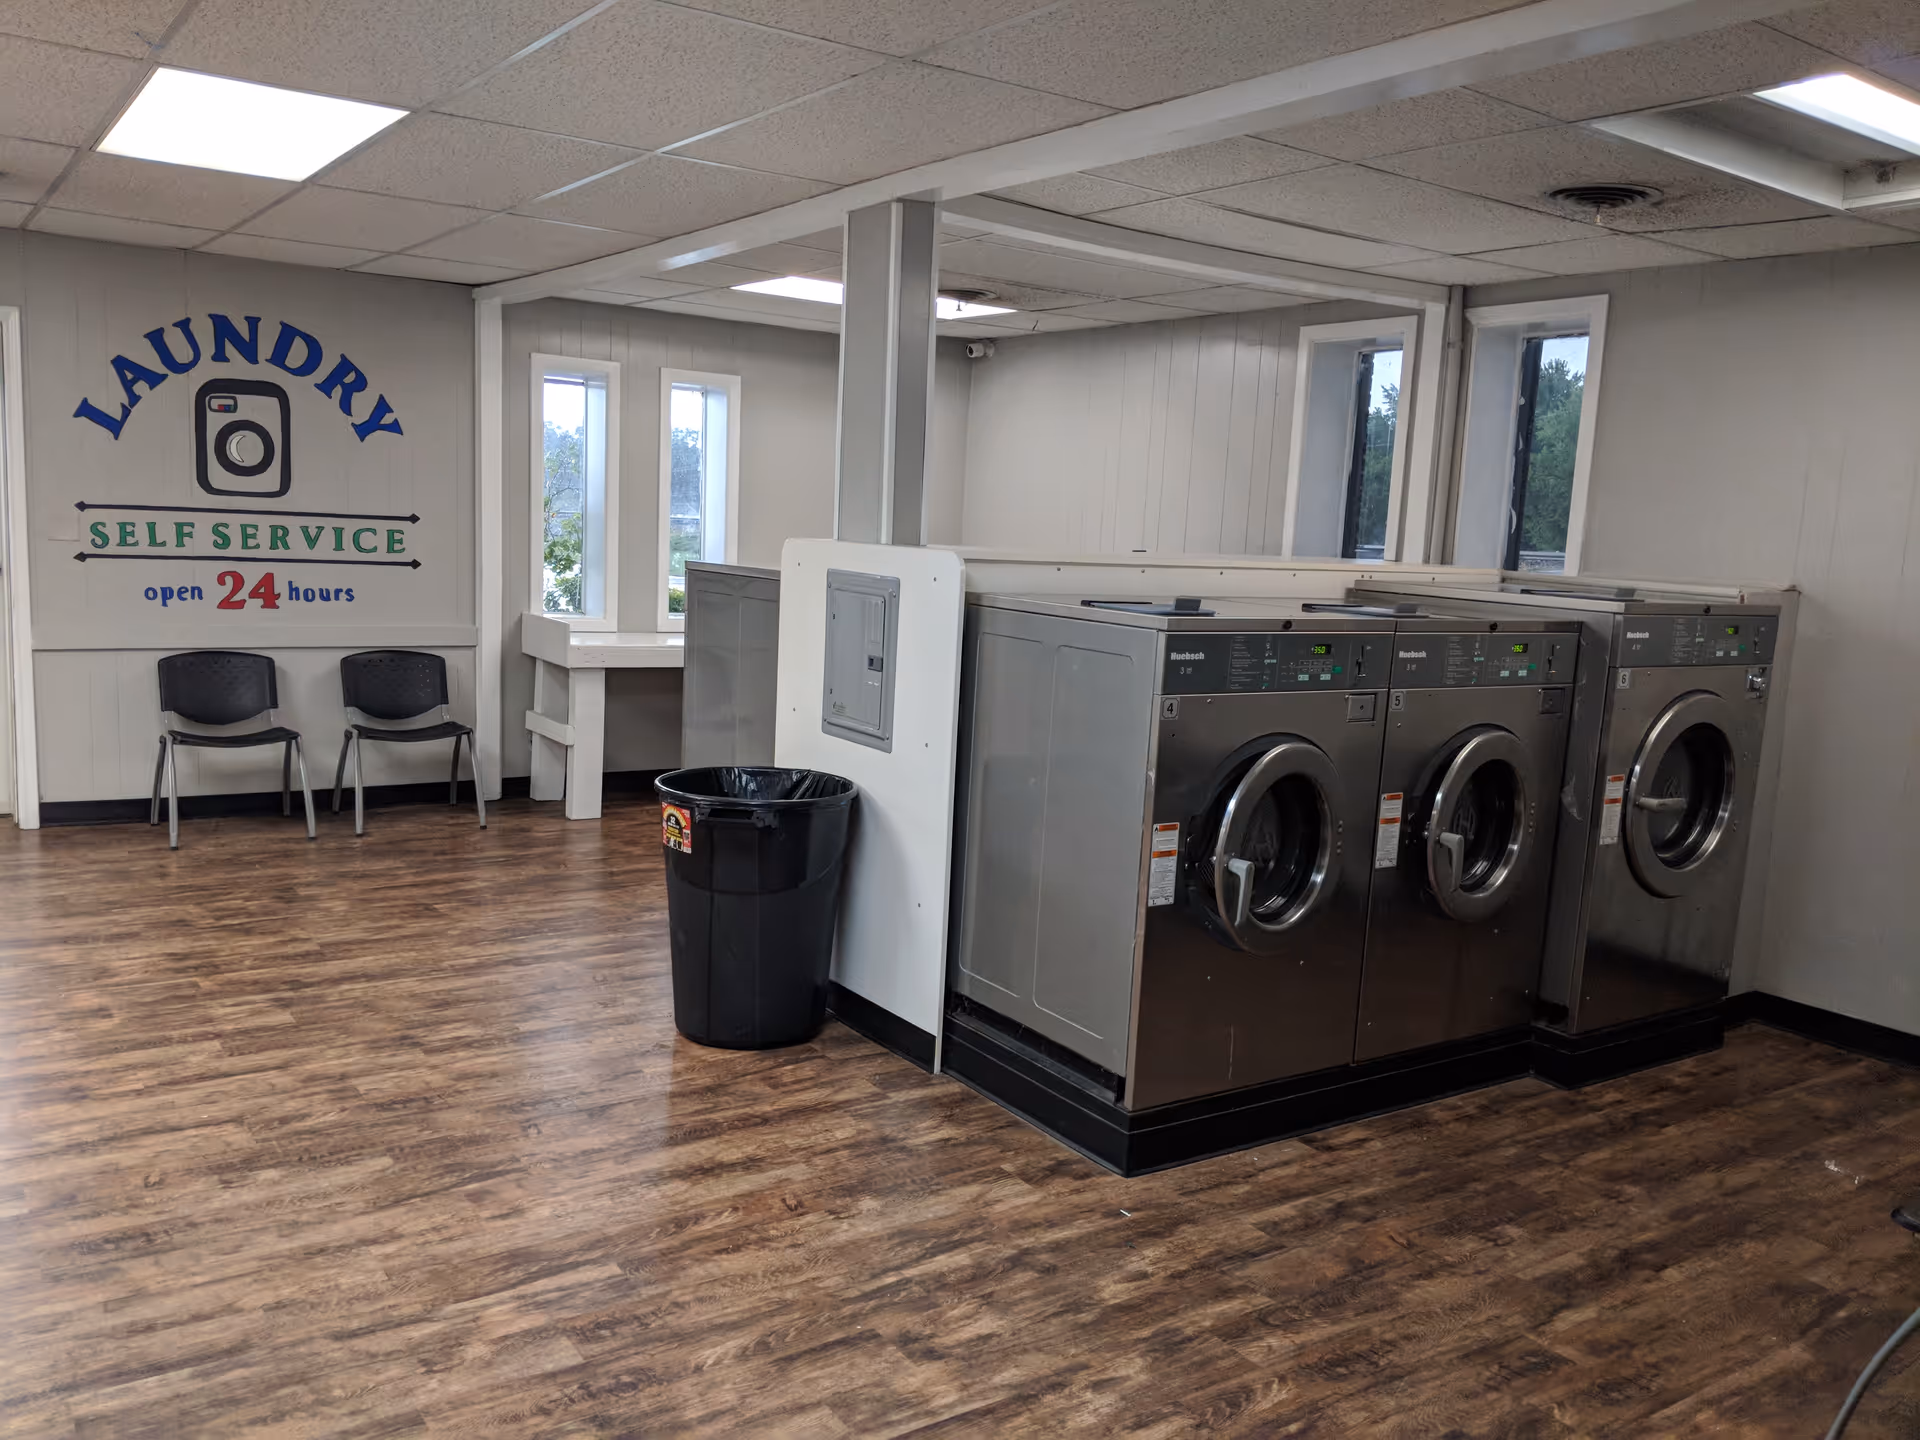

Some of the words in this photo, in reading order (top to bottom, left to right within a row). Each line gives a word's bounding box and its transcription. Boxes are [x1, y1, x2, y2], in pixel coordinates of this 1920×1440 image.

[73, 313, 404, 442] LAUNDRY
[89, 521, 195, 549] SELF
[211, 522, 406, 554] SERVICE
[143, 584, 204, 607] open
[216, 570, 281, 610] 24
[287, 580, 355, 602] hours
[1170, 651, 1205, 660] Huebsch
[1621, 674, 1627, 684] 6
[1394, 695, 1401, 707] 5
[1166, 702, 1174, 714] 4
